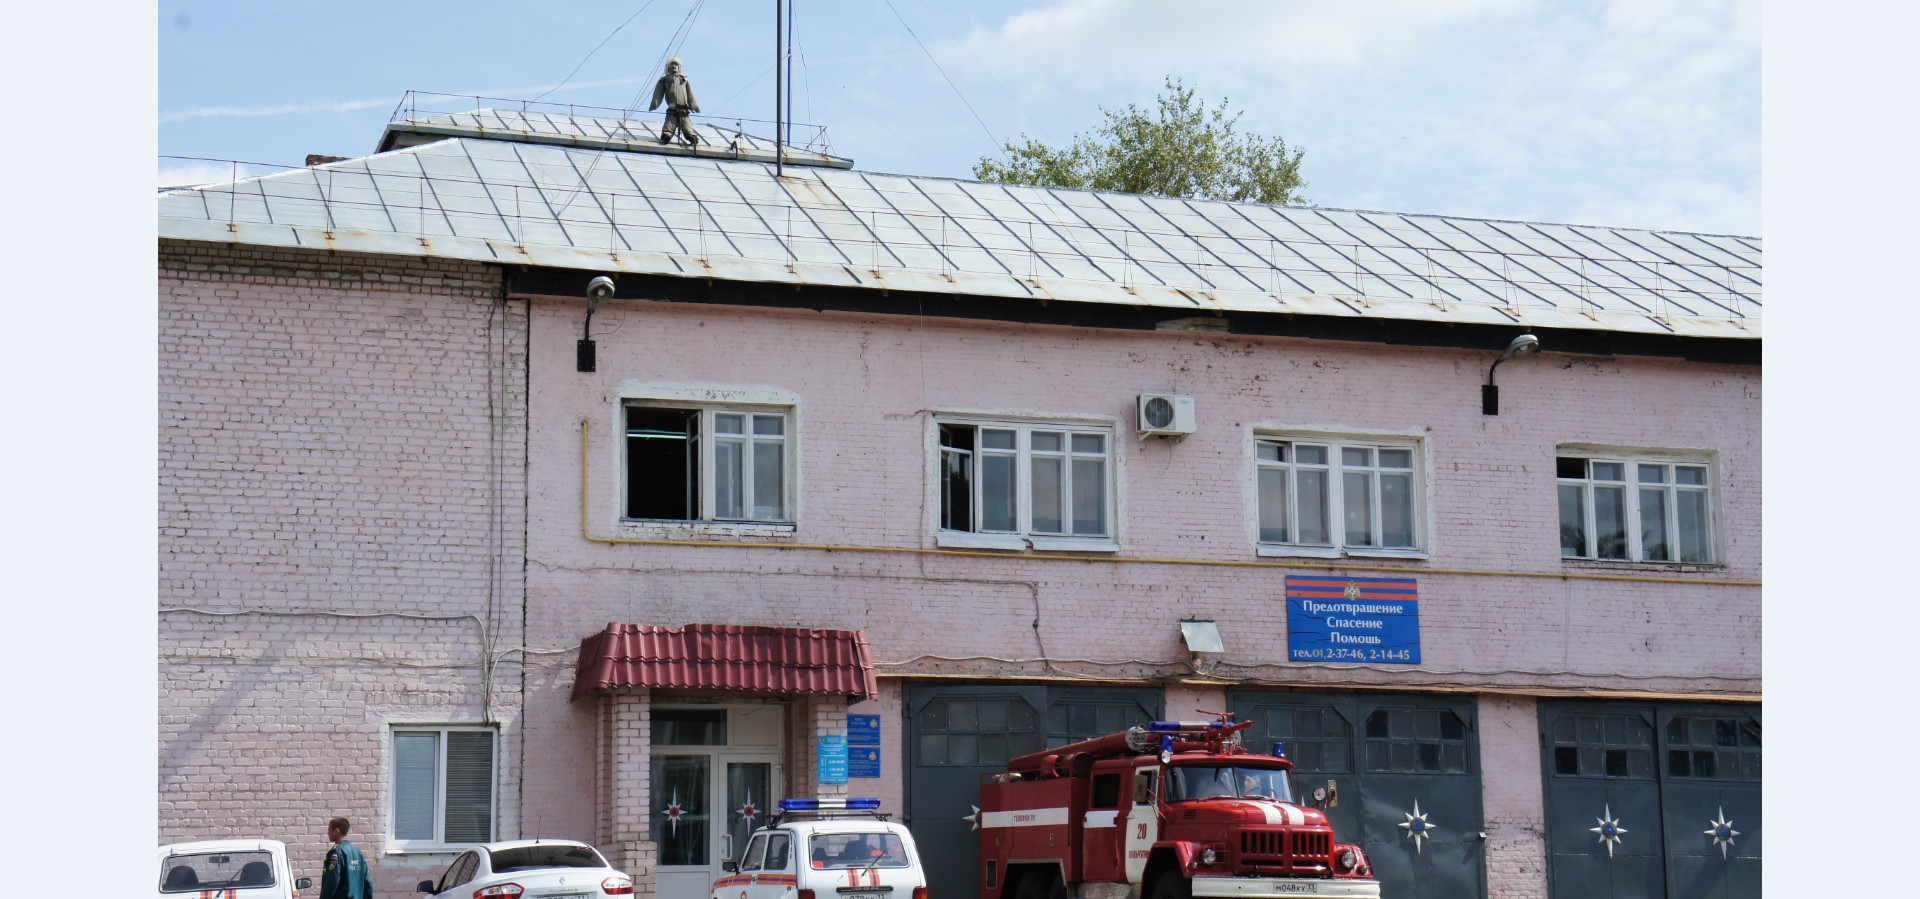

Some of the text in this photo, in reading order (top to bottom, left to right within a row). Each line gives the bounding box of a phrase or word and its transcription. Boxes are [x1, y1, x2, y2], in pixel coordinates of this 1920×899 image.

[1327, 616, 1383, 629] Спасение
[1369, 649, 1410, 660] 2-14-45
[1137, 822, 1147, 840] 20
